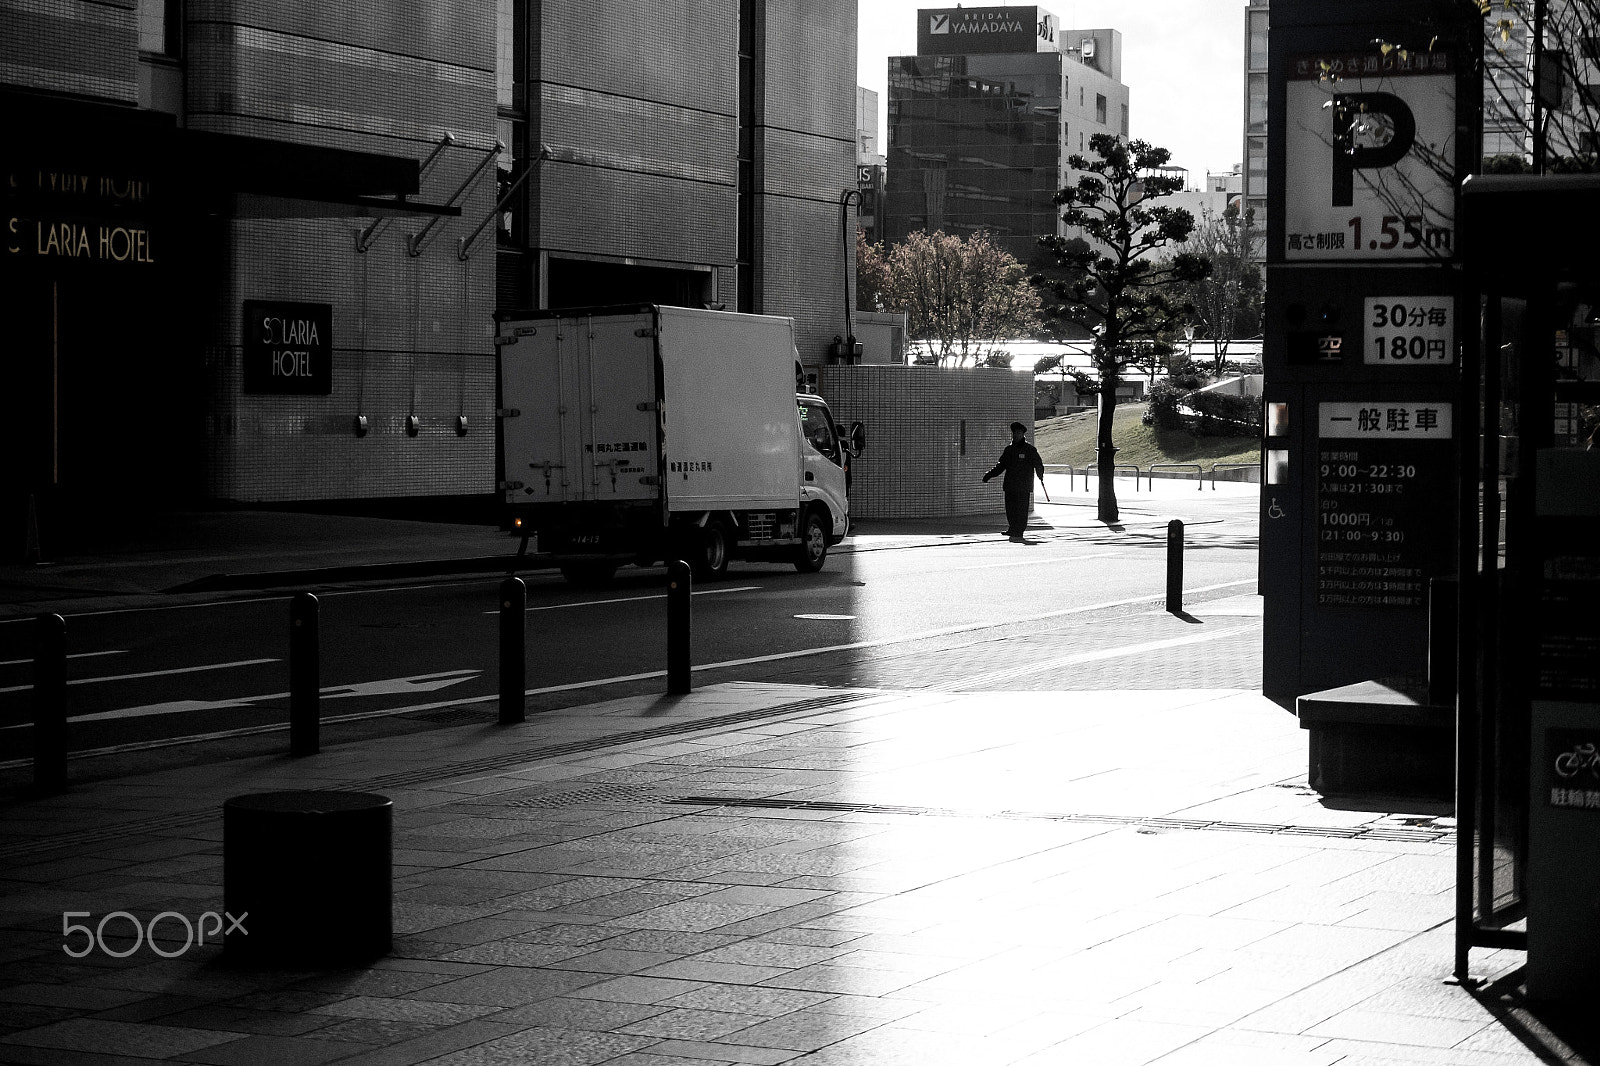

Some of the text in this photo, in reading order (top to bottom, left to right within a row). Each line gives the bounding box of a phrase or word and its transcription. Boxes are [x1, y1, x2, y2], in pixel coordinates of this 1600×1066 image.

[951, 21, 1023, 34] YAMADAYA
[1332, 92, 1416, 207] P
[99, 226, 155, 264] HOTEL
[1287, 215, 1452, 251] 高さ制限 1.55m
[1371, 303, 1448, 328] 30分毎
[262, 317, 320, 346] SOLARIA
[1316, 334, 1343, 361] 空
[1373, 335, 1446, 360] 180円
[271, 350, 313, 377] HOTEL
[1329, 407, 1439, 432] 一般駐車
